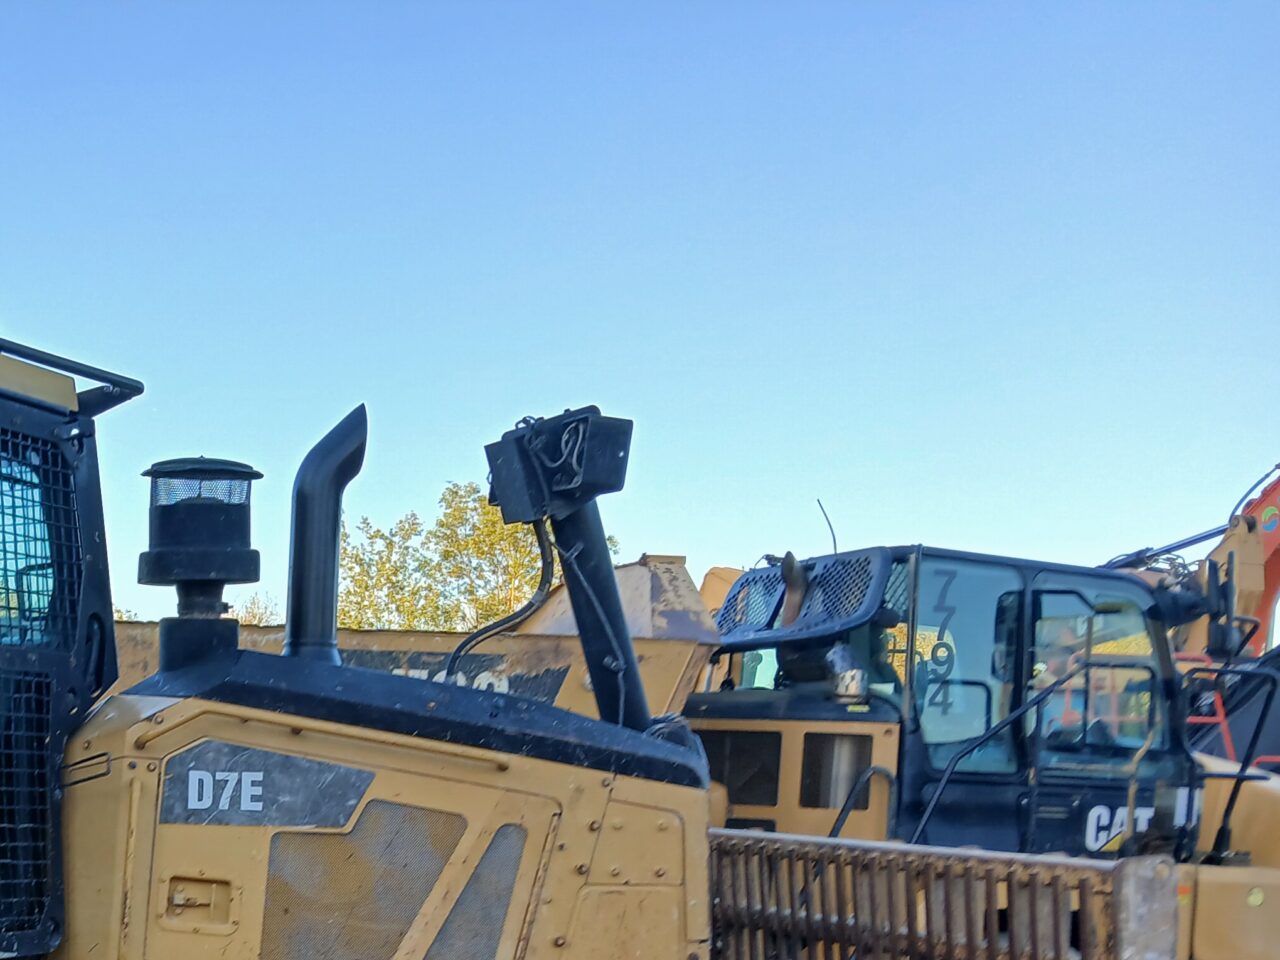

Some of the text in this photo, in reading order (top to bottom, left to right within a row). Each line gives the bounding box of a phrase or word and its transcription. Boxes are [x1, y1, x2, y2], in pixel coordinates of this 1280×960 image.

[927, 568, 958, 716] 7794
[186, 769, 264, 811] D7E
[1085, 804, 1155, 852] CAT
